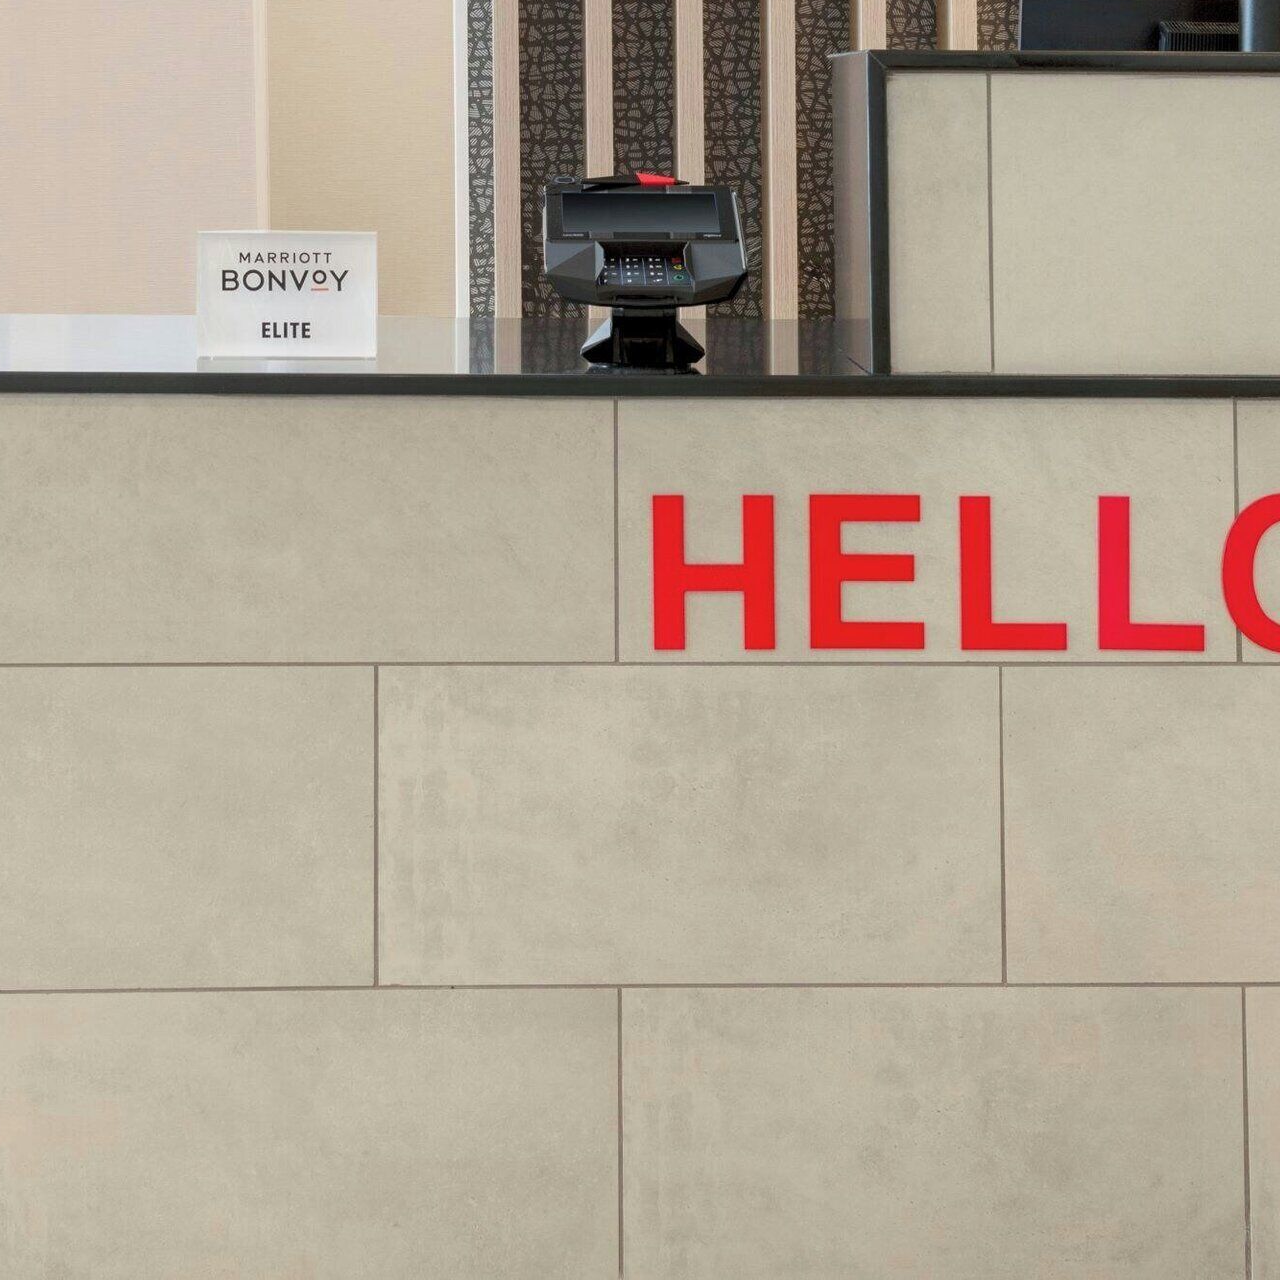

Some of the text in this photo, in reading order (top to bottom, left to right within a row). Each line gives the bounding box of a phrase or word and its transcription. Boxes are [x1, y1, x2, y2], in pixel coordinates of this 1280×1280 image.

[238, 252, 333, 264] MARRIOTT
[221, 269, 350, 292] BONVOY
[261, 322, 312, 339] ELITE
